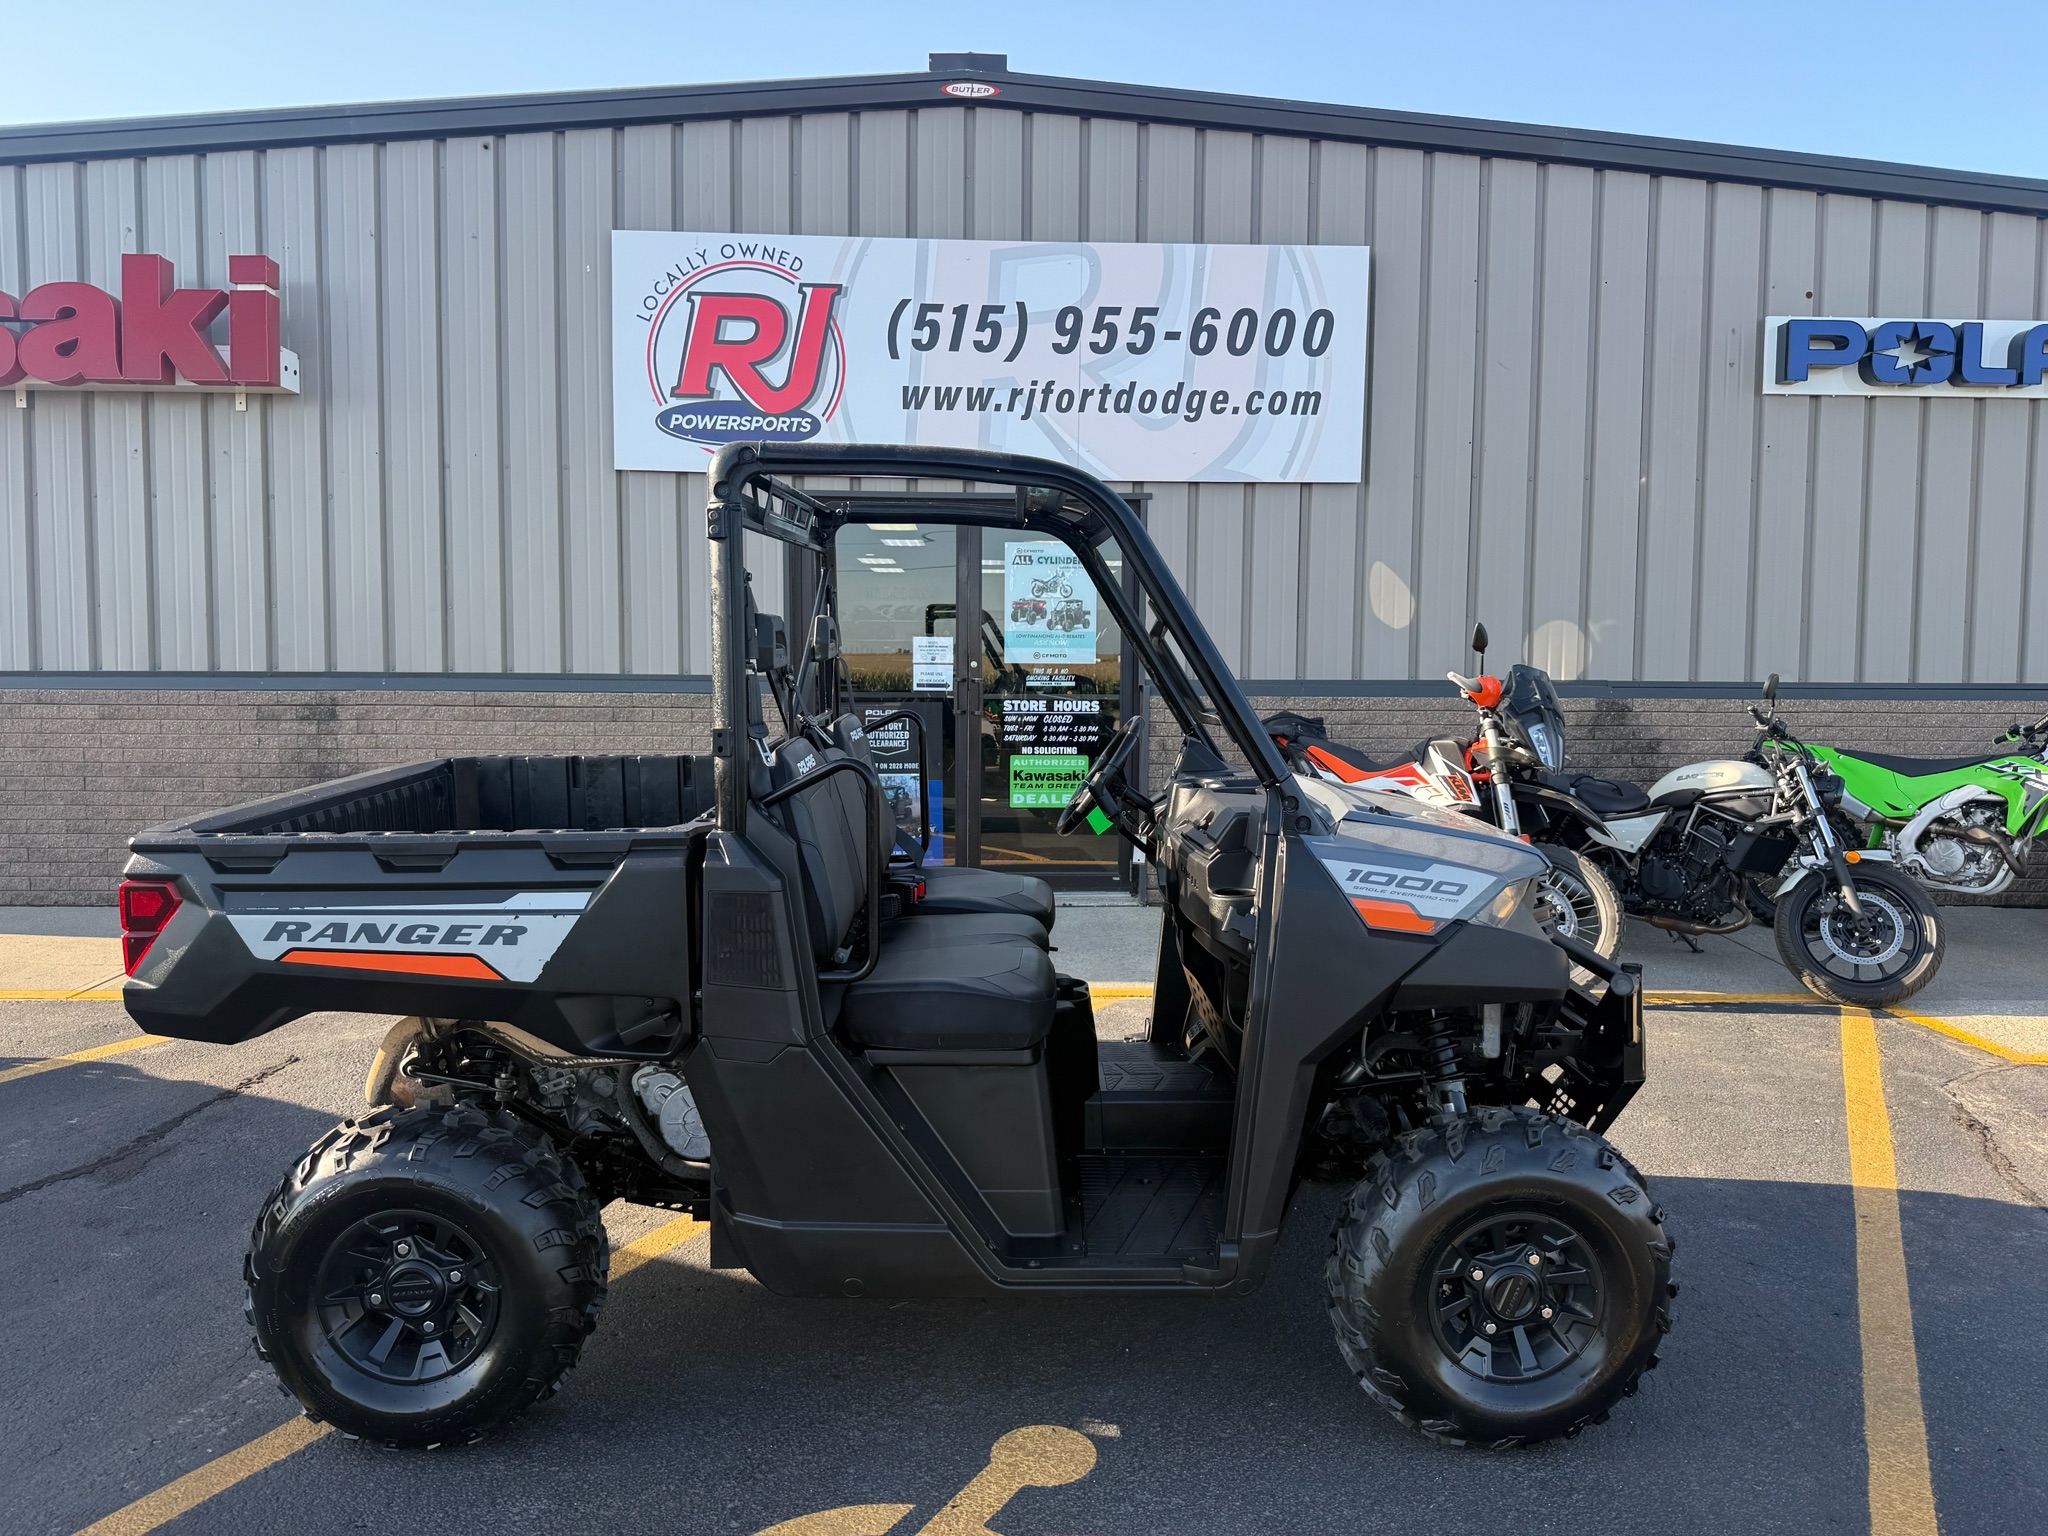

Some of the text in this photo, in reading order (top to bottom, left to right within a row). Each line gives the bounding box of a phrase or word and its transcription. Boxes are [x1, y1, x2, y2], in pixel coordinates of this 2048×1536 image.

[636, 242, 803, 323] LOCALLY OWNED
[0, 253, 281, 387] aki
[887, 299, 1336, 362] (515) 955-6000
[670, 283, 846, 415] RJ
[901, 381, 1323, 422] www.rjfortdodge.com
[669, 414, 812, 432] POWERSPORTS
[1013, 555, 1081, 565] ALL CYLINDE
[1003, 700, 1100, 711] STORE HOURS
[1043, 715, 1074, 723] CLOSED
[868, 740, 906, 748] CLEARANCE
[1013, 770, 1086, 781] Kawasaki
[1446, 773, 1474, 802] KTM
[1013, 793, 1072, 804] DEALE
[1345, 868, 1468, 897] 1000
[1353, 885, 1387, 894] SINGLE
[1389, 890, 1438, 901] OVERHEAD
[262, 921, 529, 946] RANGER
